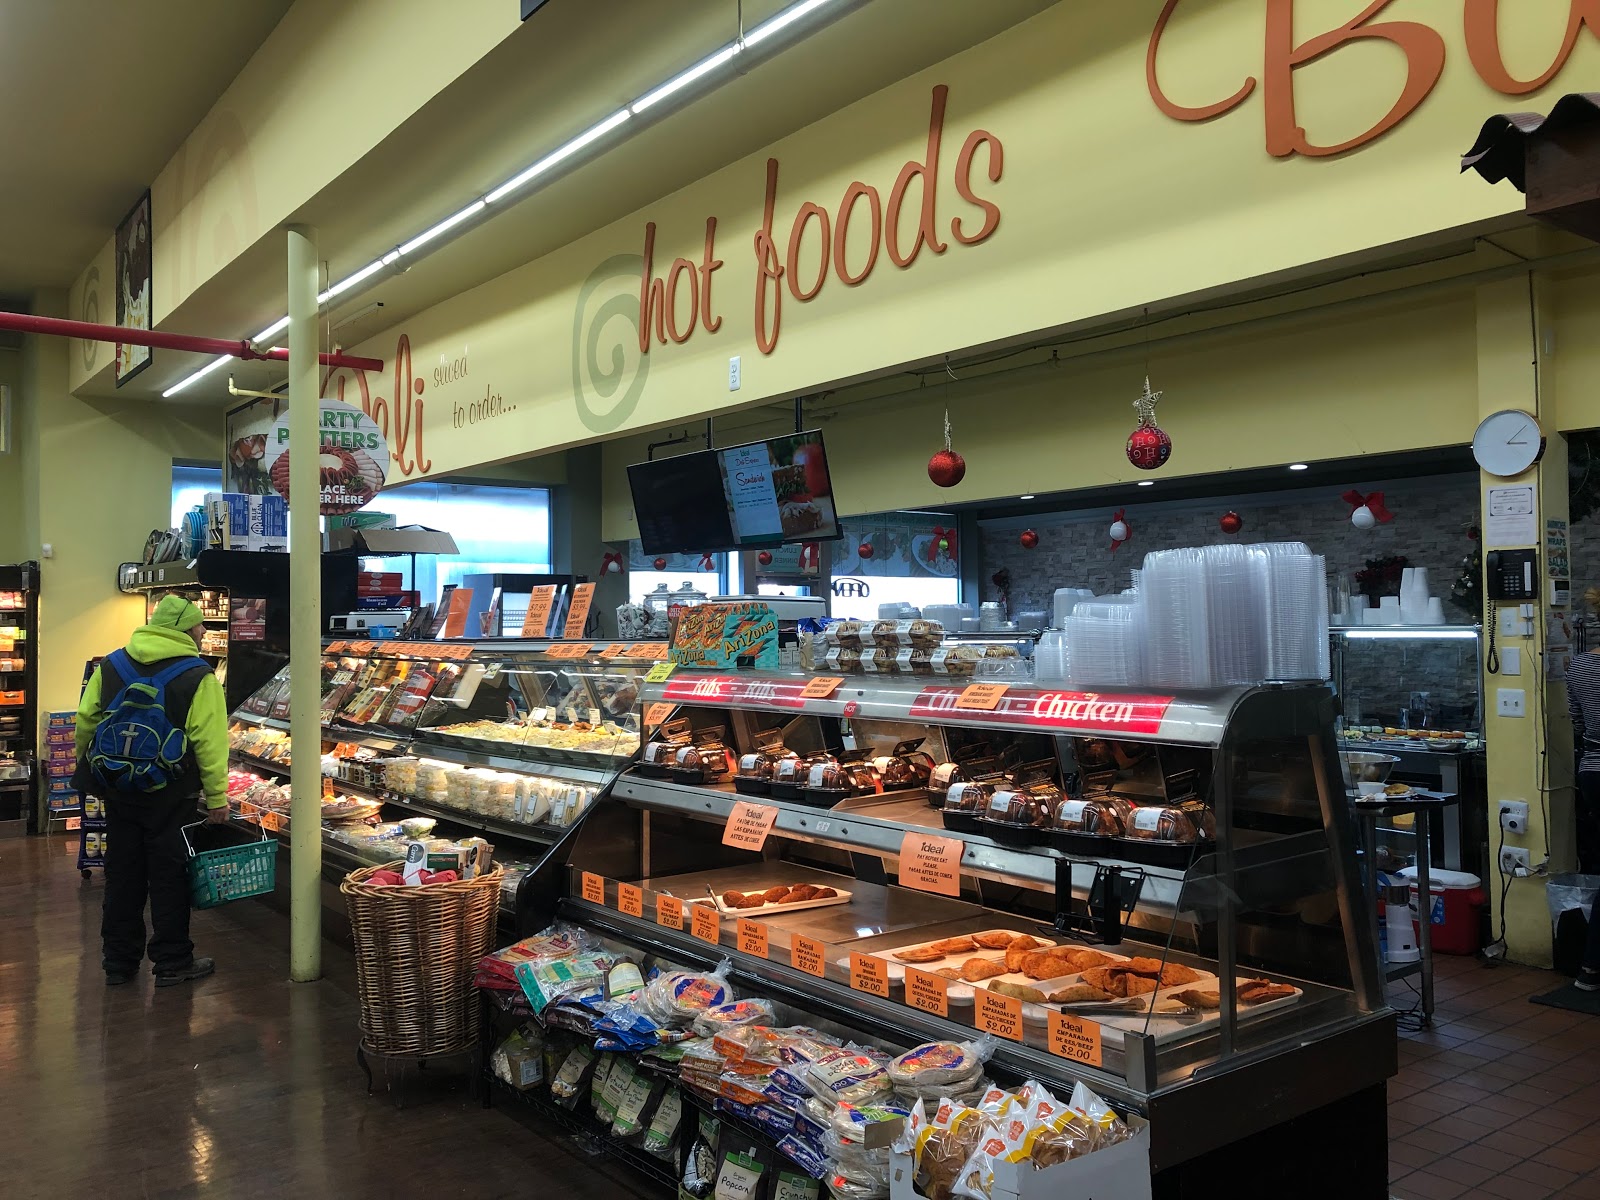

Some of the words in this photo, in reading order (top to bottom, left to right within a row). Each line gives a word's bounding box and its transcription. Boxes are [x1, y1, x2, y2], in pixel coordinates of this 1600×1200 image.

[639, 217, 724, 354] hot
[754, 85, 1004, 355] foods
[433, 344, 469, 388] sliced
[319, 410, 364, 428] RTY
[452, 401, 465, 429] to
[277, 427, 380, 449] PTTERS
[320, 484, 346, 494] LACE
[336, 495, 364, 504] HERE
[724, 620, 775, 660] AriZona
[670, 649, 705, 665] AriZona
[691, 678, 722, 697] Ribs
[744, 680, 777, 700] Ribs
[1033, 693, 1134, 722] Chicken
[624, 904, 637, 914] $2.00
[663, 917, 678, 927] $2.00
[697, 929, 712, 940] $2.00
[745, 943, 761, 953] $2.00
[798, 960, 818, 972] $2.00
[859, 980, 880, 992] $2.00
[915, 998, 939, 1011] $2.00
[985, 1020, 1013, 1035] $2.00
[1056, 1029, 1094, 1044] EMPANADAS
[1064, 1038, 1095, 1050] RES/BEEF
[1060, 1044, 1090, 1060] $2.00
[829, 1059, 856, 1070] SMAR
[721, 1175, 750, 1194] Popcorn
[780, 1186, 813, 1200] Crunchy
